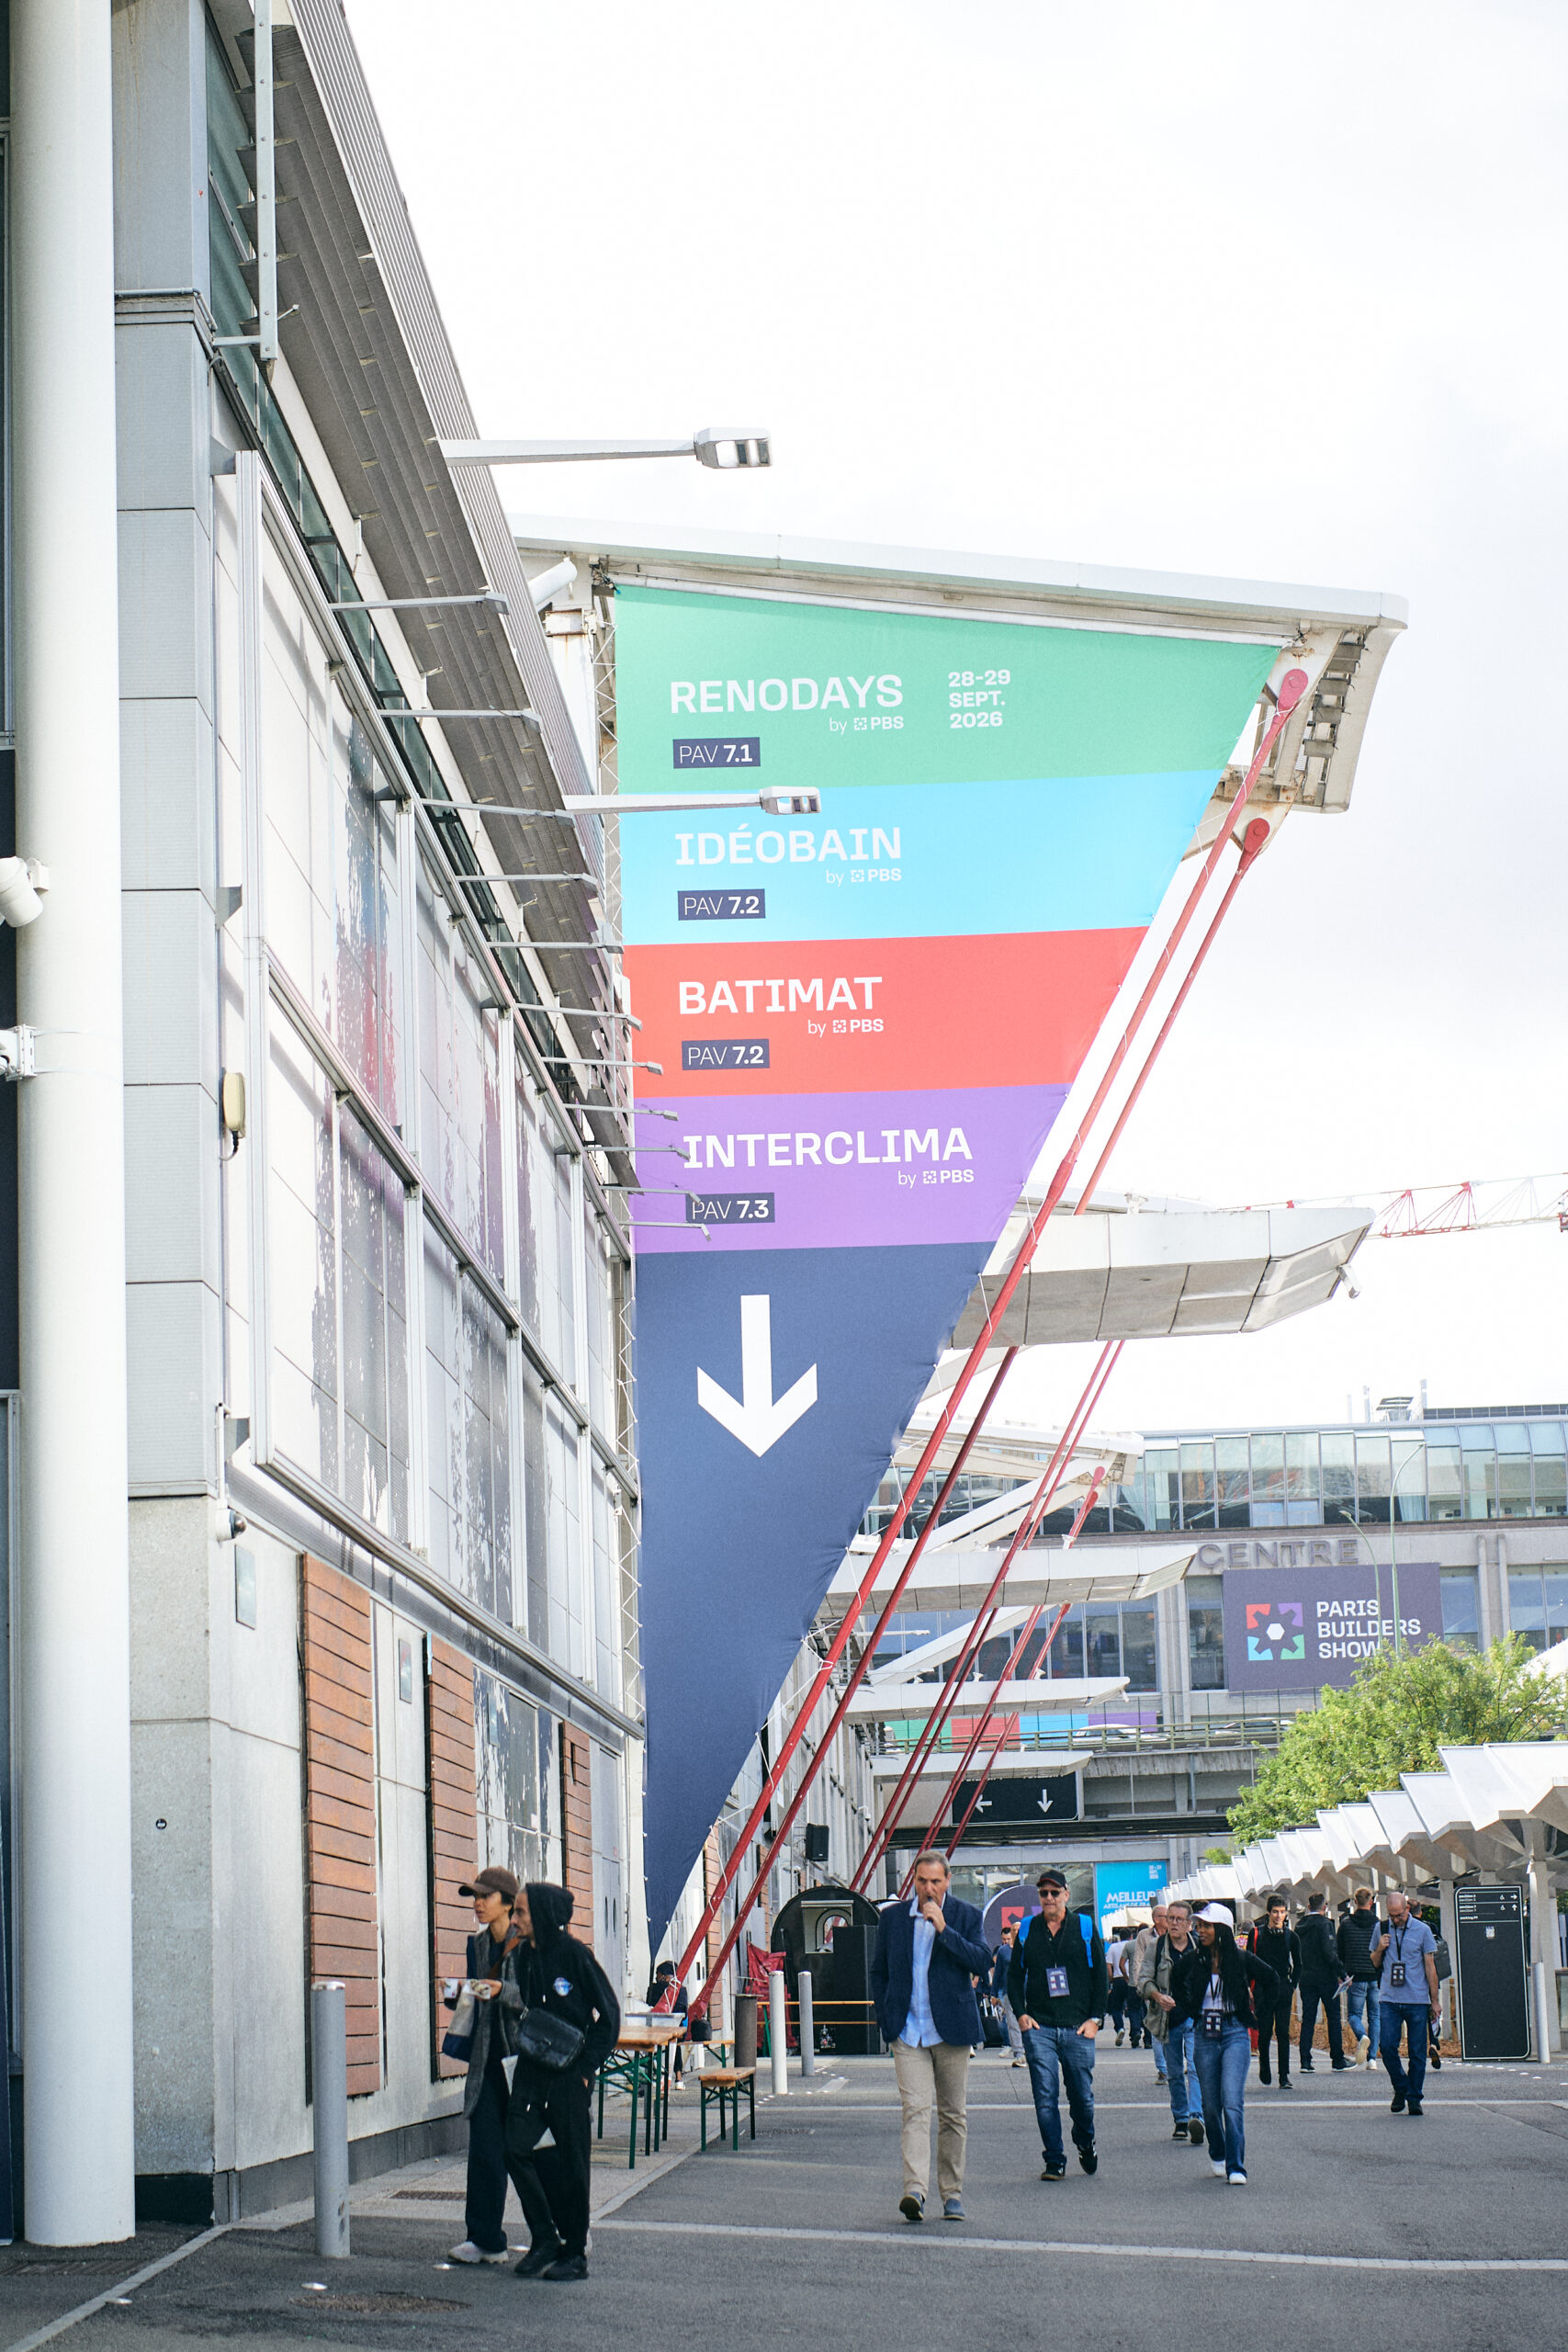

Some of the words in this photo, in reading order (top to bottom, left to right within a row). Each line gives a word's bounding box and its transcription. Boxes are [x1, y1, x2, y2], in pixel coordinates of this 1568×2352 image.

[948, 669, 1011, 687] 28-29
[671, 674, 904, 714] RENODAYS
[949, 690, 1006, 707] SEPT.
[829, 718, 847, 734] by
[871, 716, 904, 730] PBS
[950, 712, 1003, 729] 2026
[679, 744, 718, 763] PAV
[723, 743, 753, 763] 7.1
[675, 822, 901, 865] IDÉOBAIN
[827, 869, 844, 888] by
[868, 867, 902, 882] PBS
[684, 897, 723, 915] PAV
[728, 895, 760, 914] 7.2
[679, 976, 883, 1014] BATIMAT
[808, 1019, 827, 1037] by
[851, 1018, 885, 1033] PBS
[688, 1046, 728, 1067] PAV
[732, 1045, 764, 1064] 7.2
[682, 1127, 973, 1169] INTERCLIMA
[898, 1170, 917, 1189] by
[941, 1169, 975, 1183] PBS
[692, 1201, 732, 1220] PAV
[737, 1199, 770, 1219] 7.3
[1198, 1539, 1359, 1569] CENTRE
[1316, 1600, 1380, 1617] PARIS
[1317, 1619, 1421, 1638] BUILDERS
[1318, 1641, 1380, 1659] SHOW
